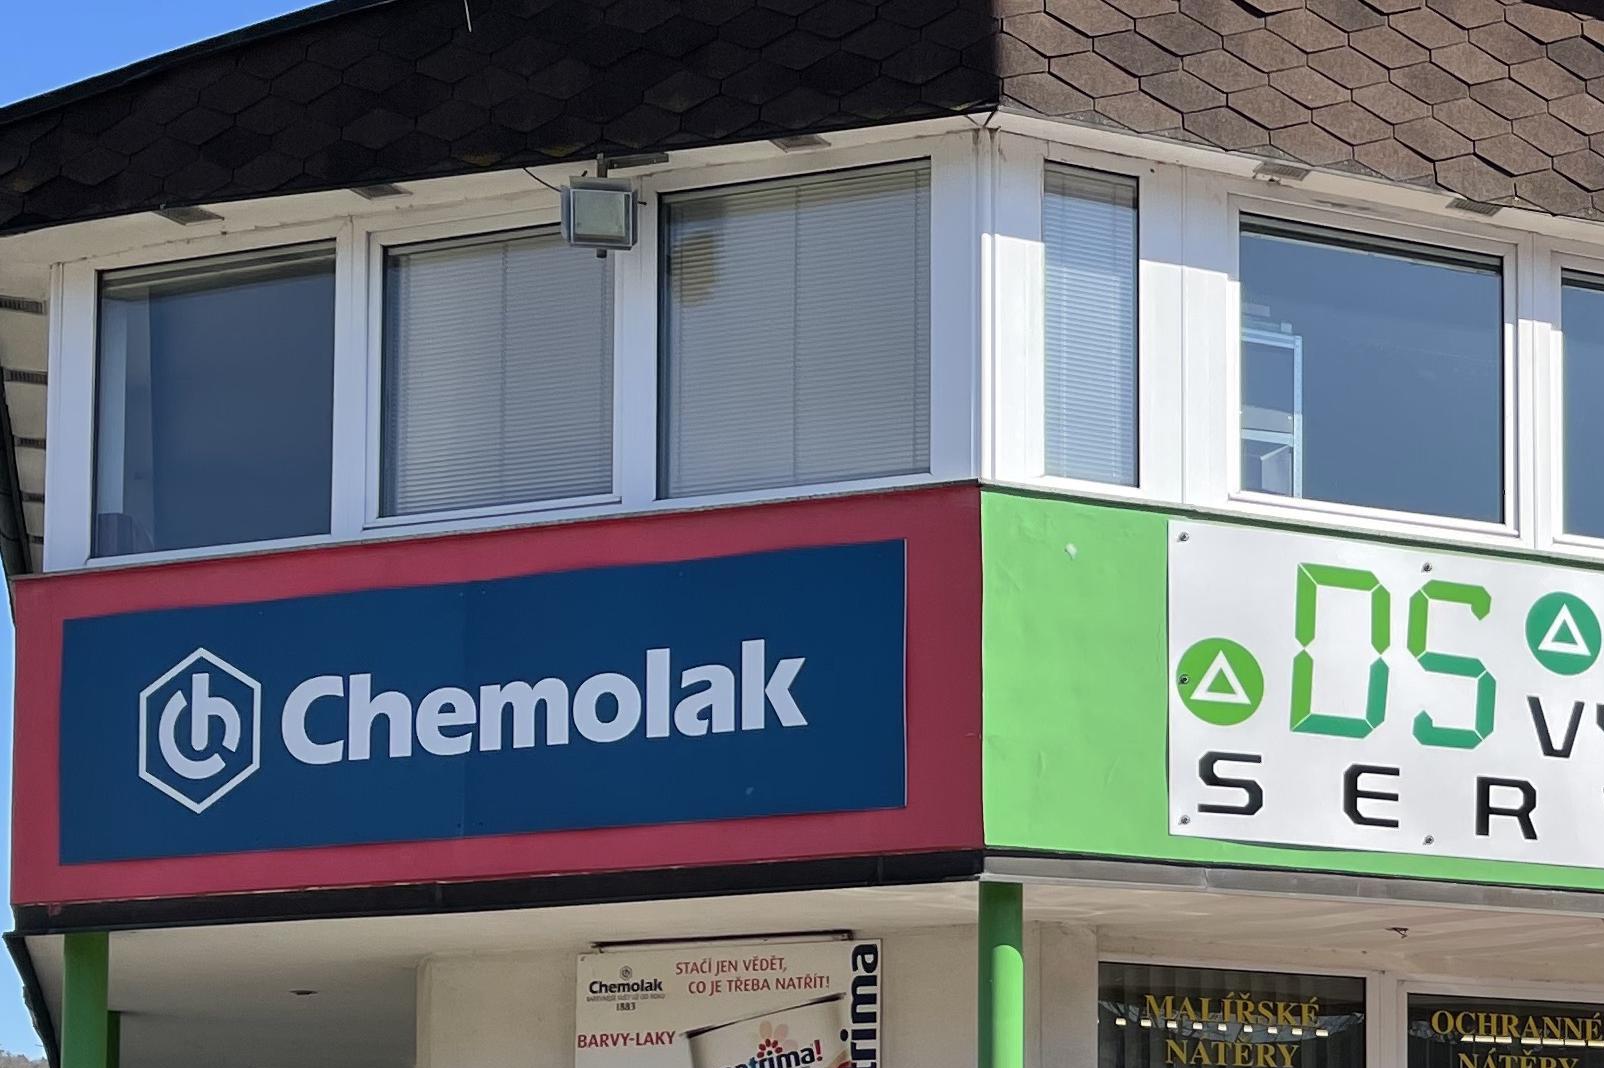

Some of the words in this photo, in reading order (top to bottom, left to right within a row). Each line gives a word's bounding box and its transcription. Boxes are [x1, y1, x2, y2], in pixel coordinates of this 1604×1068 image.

[281, 638, 808, 766] Chemolak
[675, 957, 712, 976] STAČÍ
[715, 959, 738, 975] JEN
[742, 957, 788, 973] VĚDĚT,
[589, 978, 664, 995] Chemolak
[688, 979, 707, 995] CO
[709, 979, 723, 995] JE
[726, 975, 771, 993] TŘEBA
[775, 975, 830, 991] NATŘÍT!
[1143, 992, 1320, 1028] MALÍŘSKÉ
[1431, 1010, 1603, 1042] OCHRANNÉ
[577, 1030, 677, 1049] BARVY-LAKY
